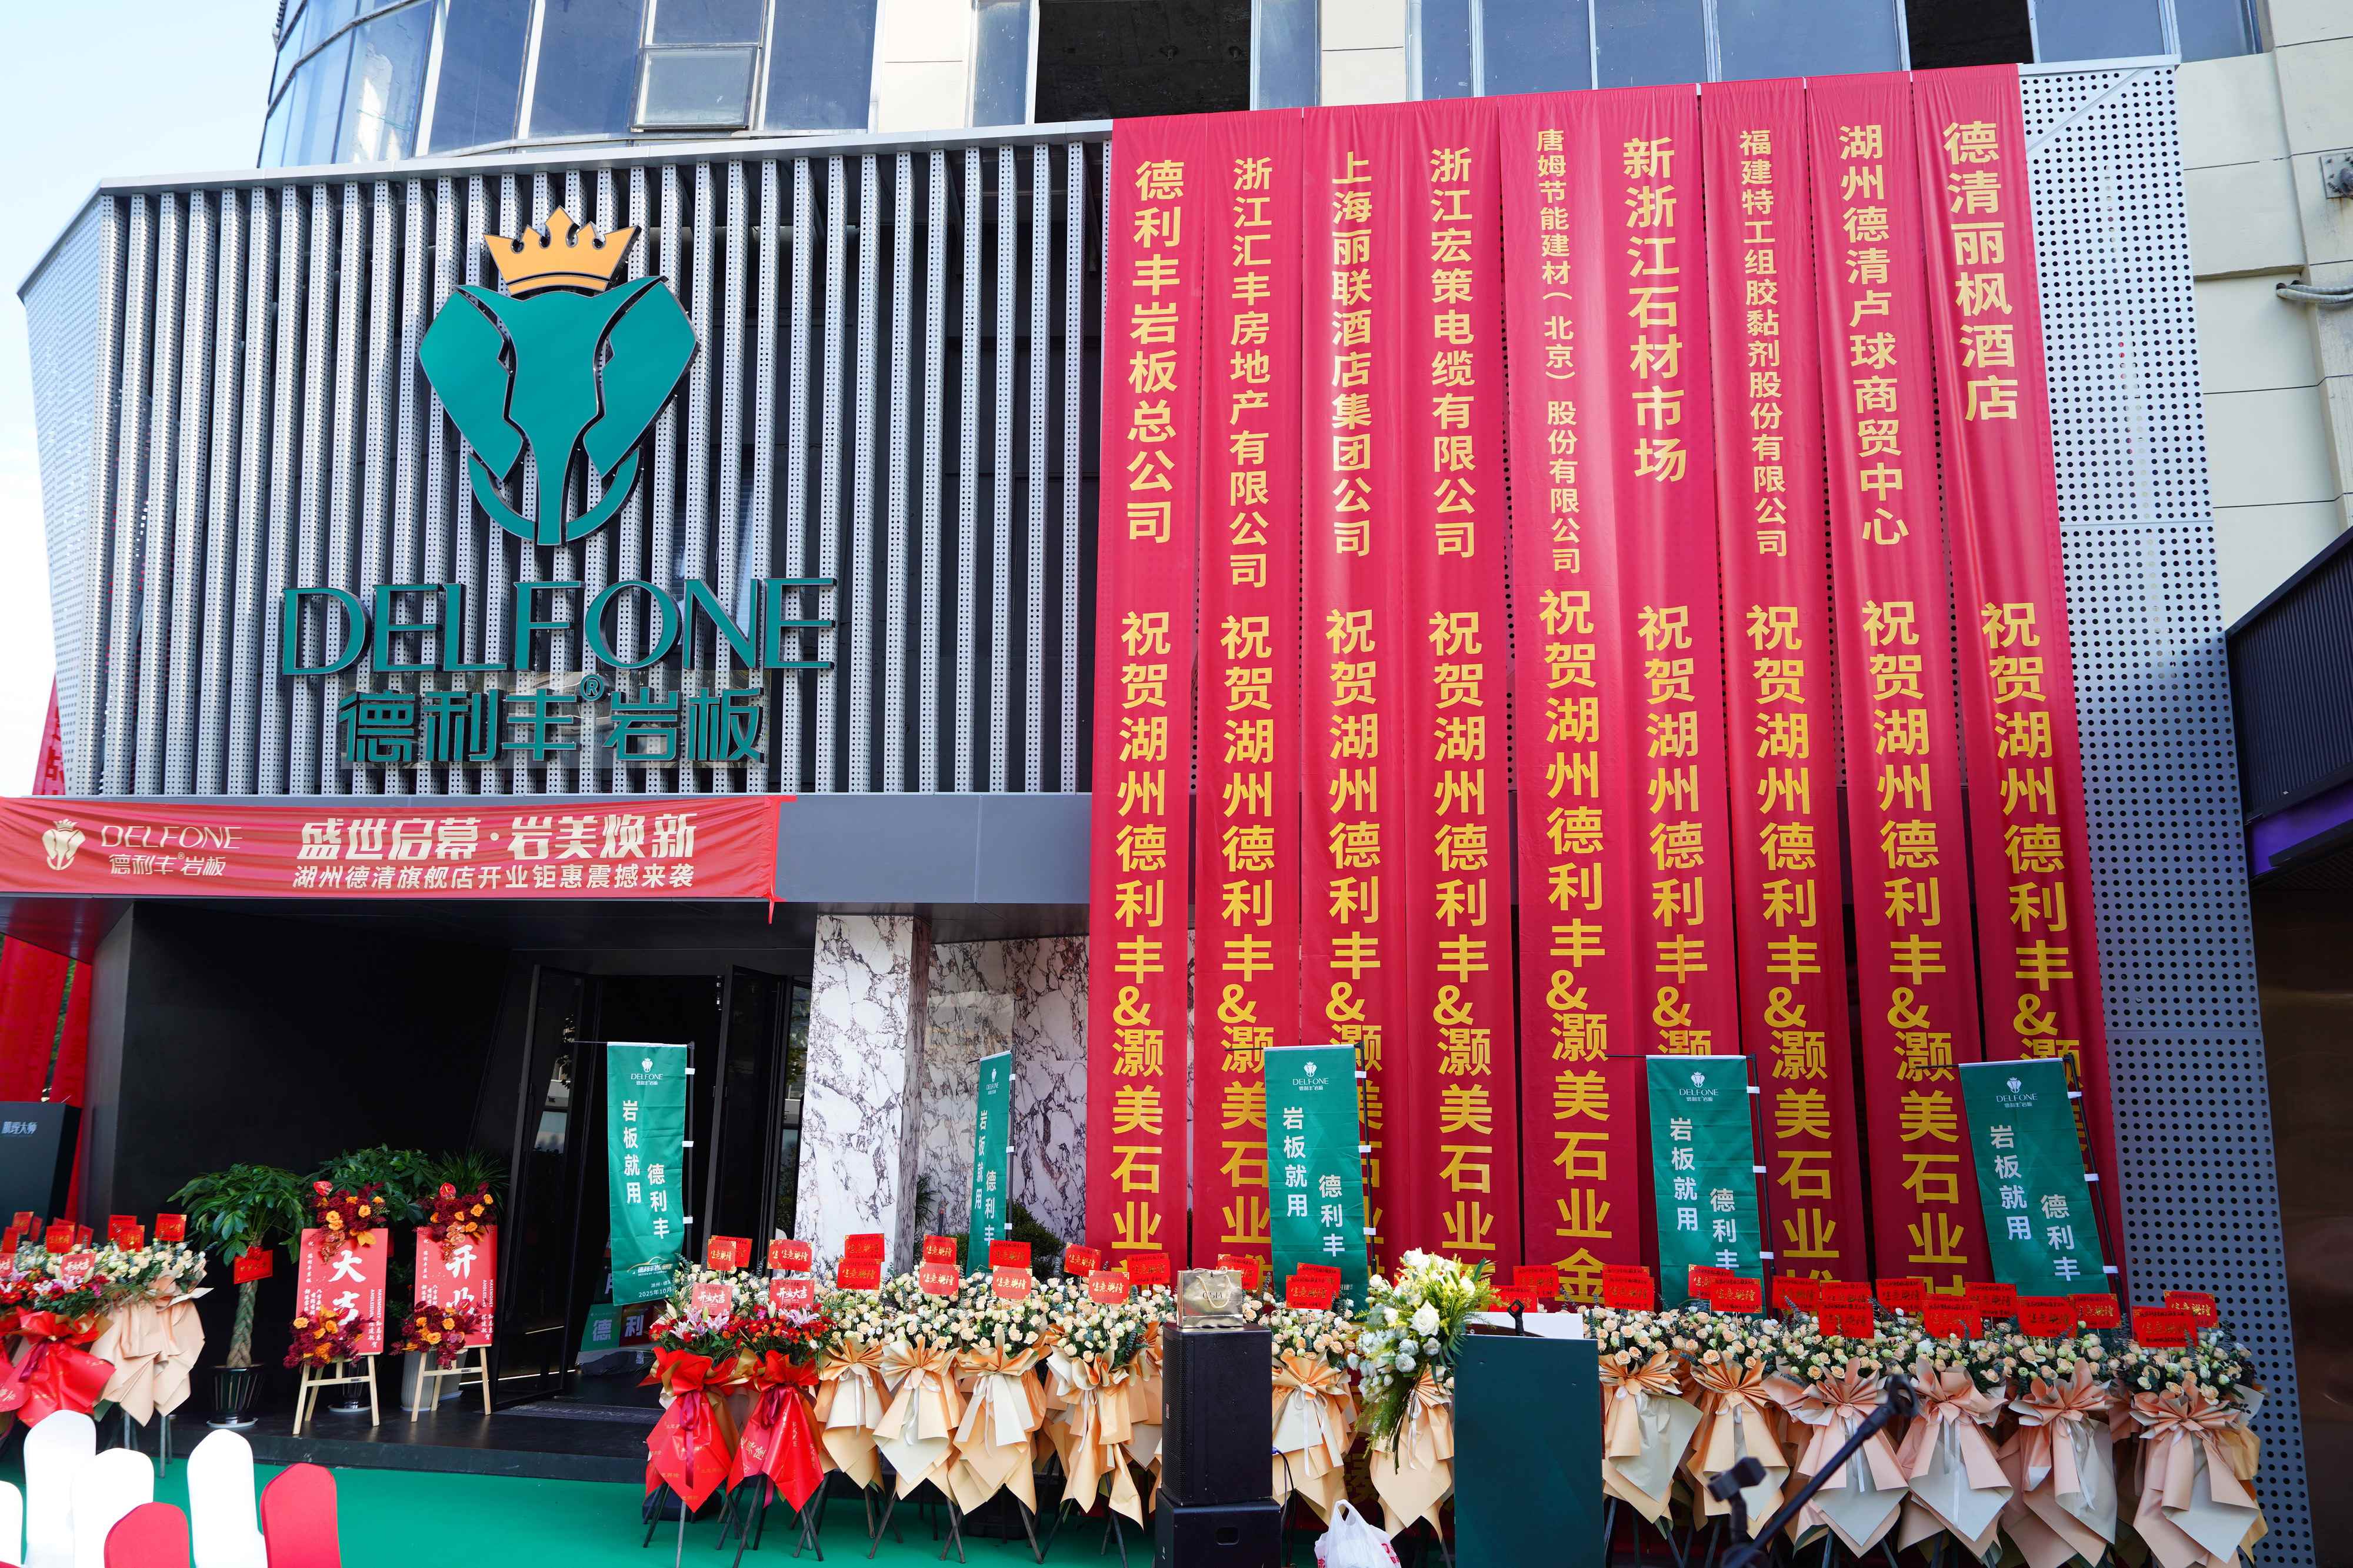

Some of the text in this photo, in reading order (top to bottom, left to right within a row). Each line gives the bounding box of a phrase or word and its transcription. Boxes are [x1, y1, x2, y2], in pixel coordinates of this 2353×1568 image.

[1623, 136, 1687, 483] 新浙江石材市场
[1944, 121, 2018, 422] 德清丽枫酒店
[1126, 159, 1185, 544] 德利丰岩板总公司
[1229, 156, 1273, 589] 浙江汇丰房地产有限公司
[1331, 151, 1372, 558] 上海丽联酒店集团公司
[1740, 129, 1788, 557] 福建特工组胶黏剂股份有限公司
[1838, 124, 1909, 546] 湖州德清卢球商贸中心
[282, 578, 838, 676] DELFONE
[1429, 147, 1495, 1273] 浙江宏策电缆有限公司 祝贺湖州德利丰&灏美石业
[101, 825, 242, 849] DELFONE
[292, 863, 694, 890] 湖州德清旗舰店开业钜惠震撼来袭
[1111, 610, 1171, 1294] 祝贺湖州德利丰&灏美石业
[1747, 605, 1841, 1282] 祝贺湖州德利丰&灏美石业
[1679, 1088, 1719, 1096] DELFONE
[1996, 1093, 2038, 1102] DELFONE
[622, 1100, 642, 1205] 岩板就用
[647, 1163, 670, 1240] 德利丰
[974, 1109, 988, 1210] 岩板就用
[1283, 1106, 1308, 1217] 岩板就用
[1669, 1117, 1699, 1232] 岩板就用
[1990, 1124, 2032, 1242] 岩板就用
[984, 1170, 997, 1246] 德利丰
[1318, 1175, 1345, 1257] 德利丰
[1709, 1188, 1740, 1270] 德利丰
[2040, 1194, 2081, 1281] 德利丰
[592, 1313, 644, 1342] 德 利
[698, 1289, 726, 1305] 开业大吉
[777, 1286, 808, 1302] 开业大吉
